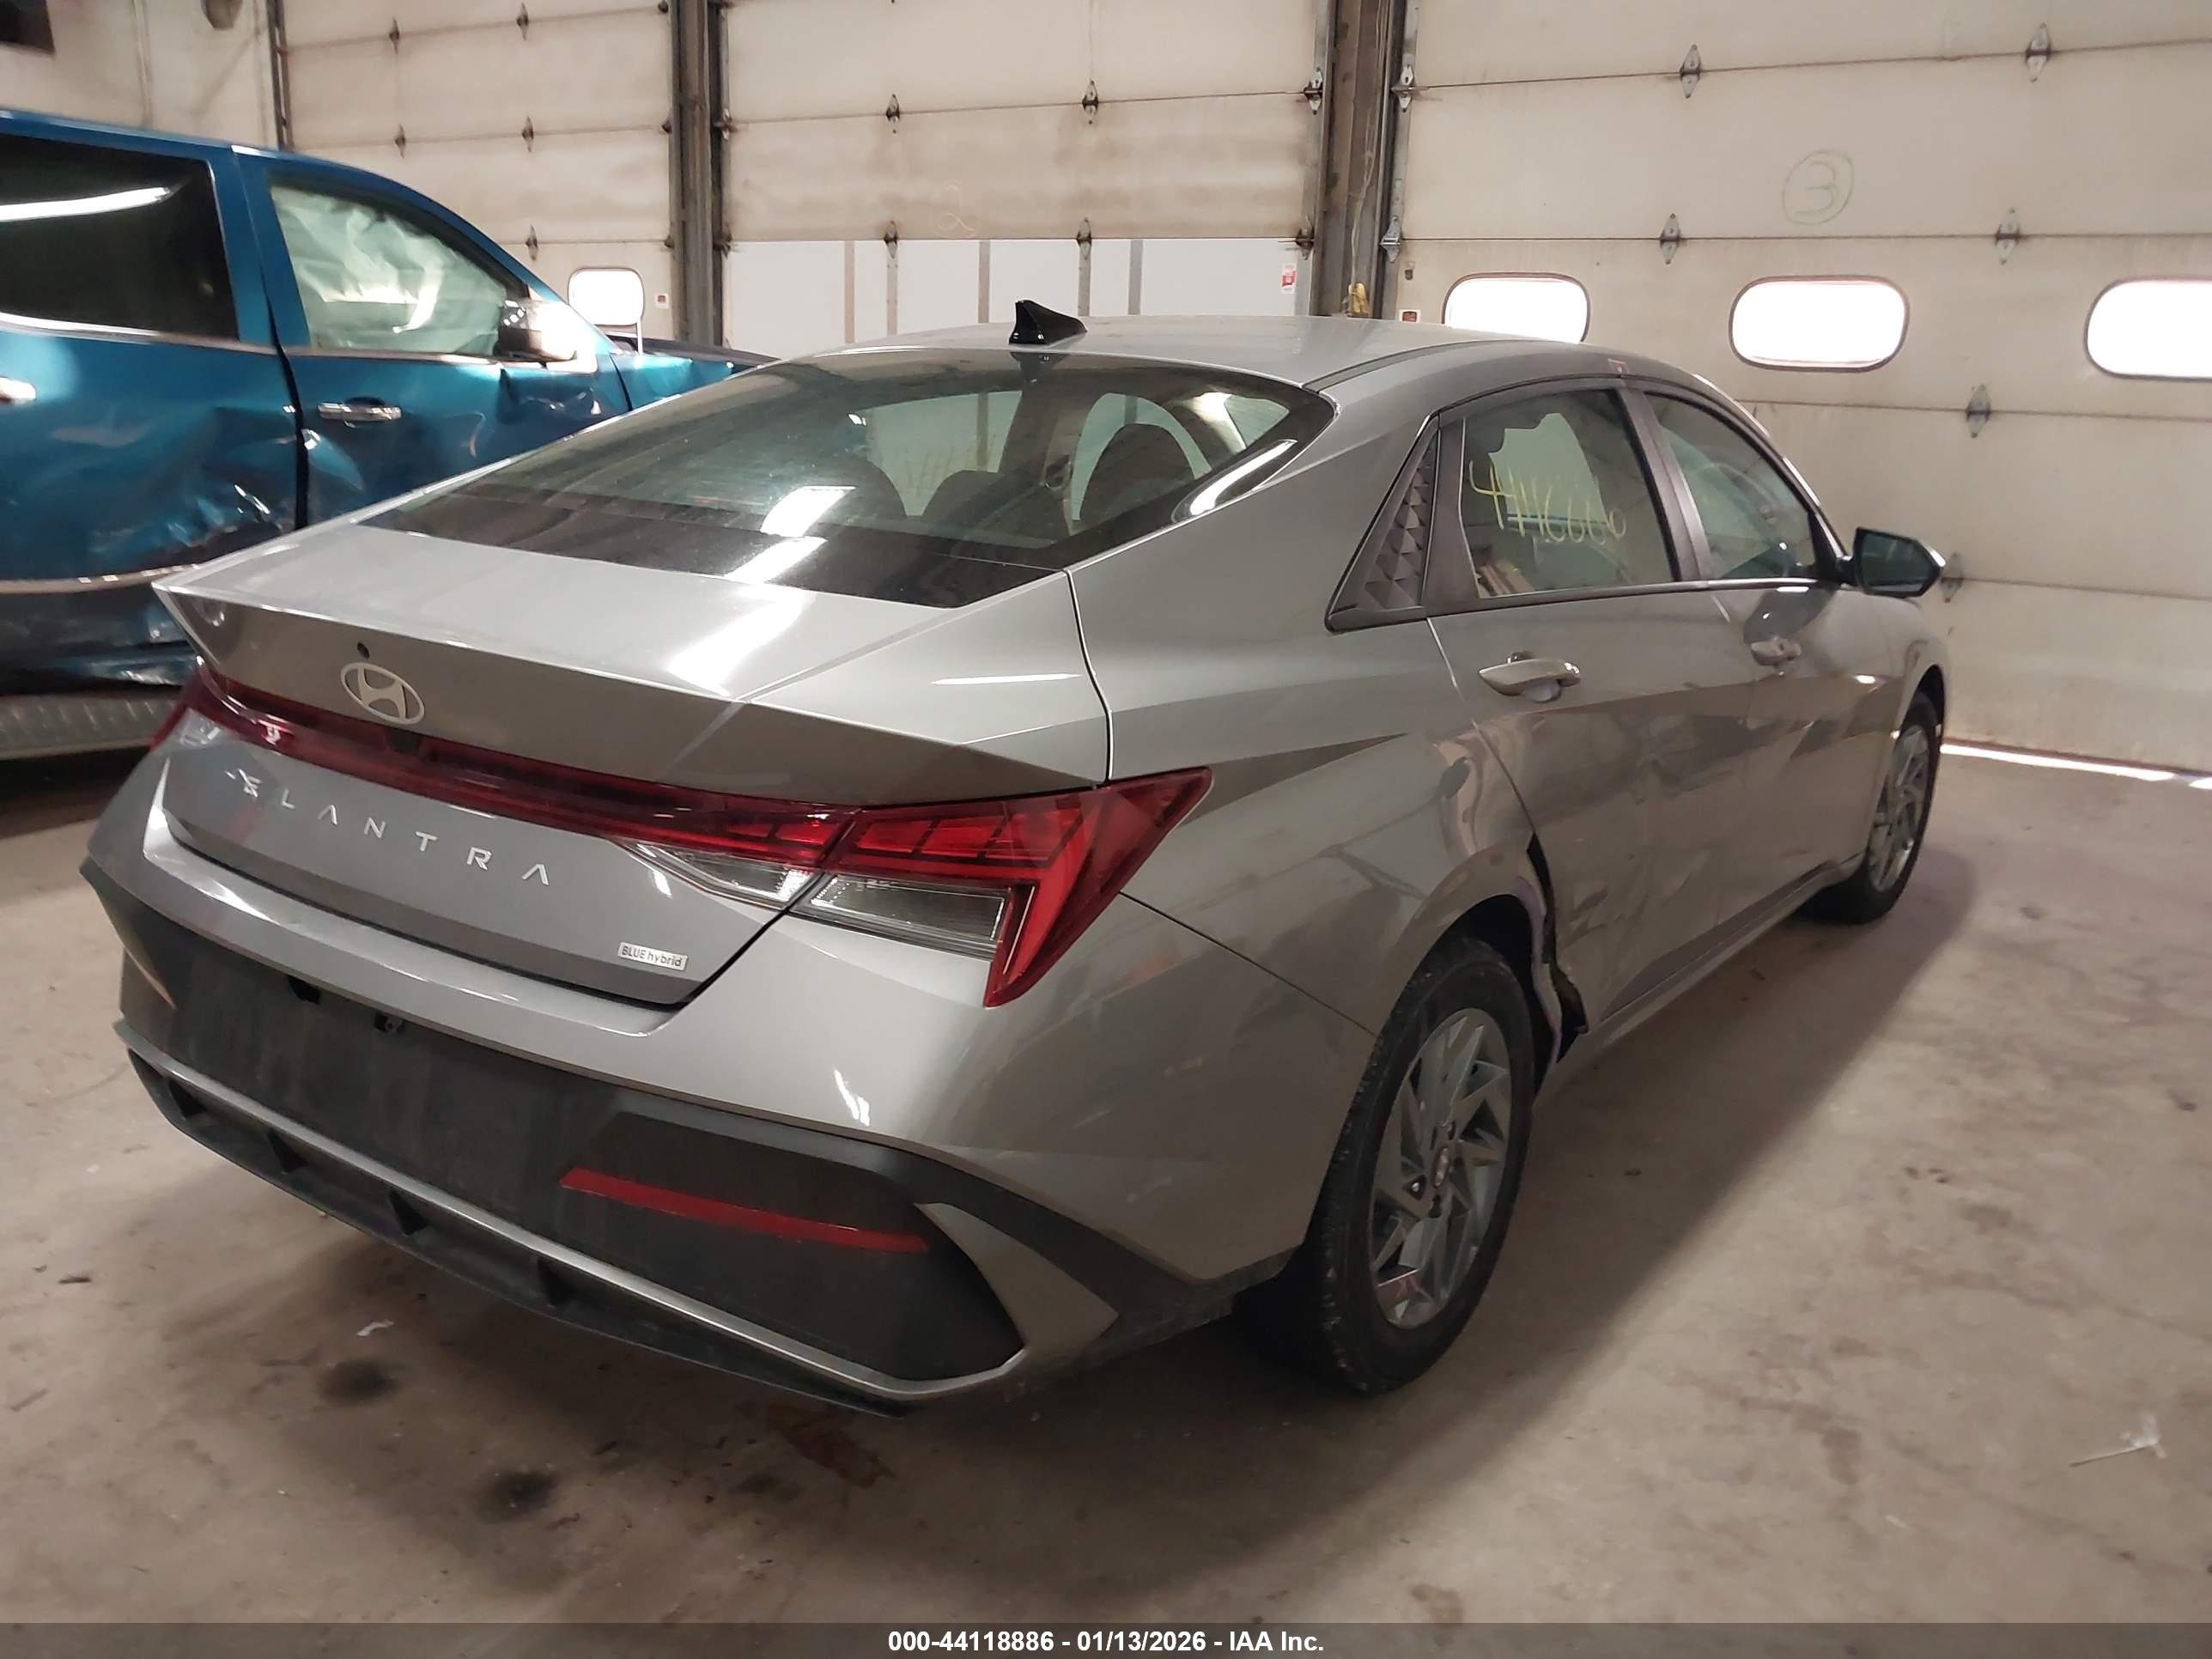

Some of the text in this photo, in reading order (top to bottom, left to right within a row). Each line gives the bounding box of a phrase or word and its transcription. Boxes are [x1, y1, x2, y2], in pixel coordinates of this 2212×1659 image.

[237, 768, 550, 886] ELANTRA
[622, 945, 684, 967] BLUE hybrid
